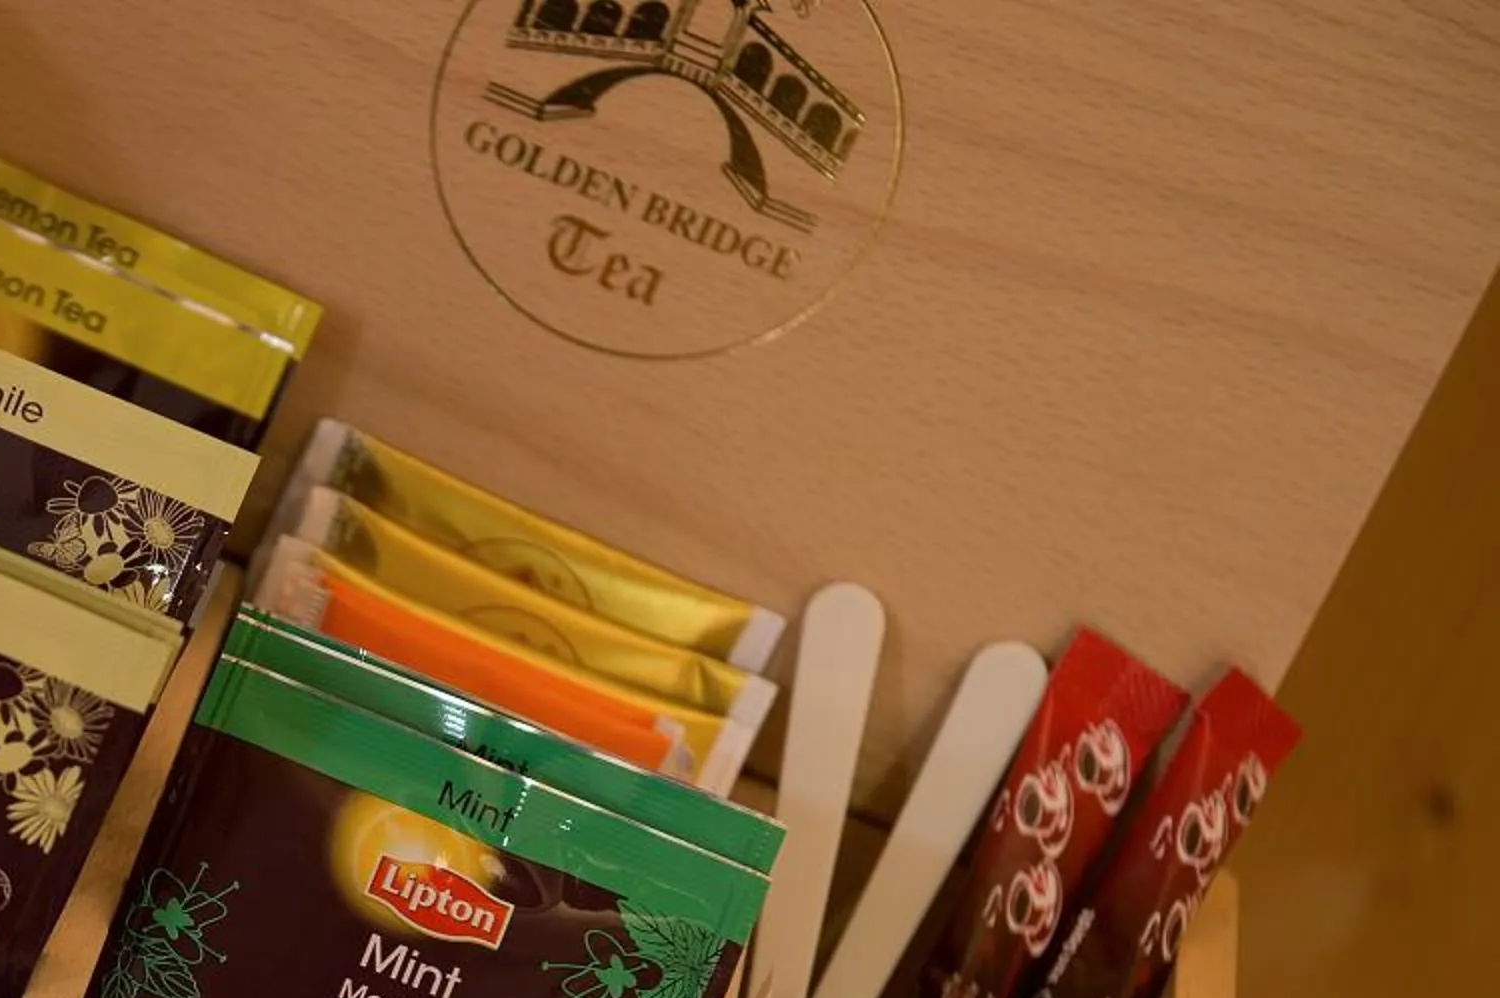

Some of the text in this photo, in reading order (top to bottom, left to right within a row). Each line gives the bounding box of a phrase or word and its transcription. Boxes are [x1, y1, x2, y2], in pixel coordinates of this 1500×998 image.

[464, 121, 802, 280] GOLDEN BRIDGE
[86, 222, 139, 270] Tea
[547, 214, 664, 306] Tea
[51, 287, 107, 335] Tea
[438, 780, 515, 833] Mint
[382, 864, 496, 933] Lipton
